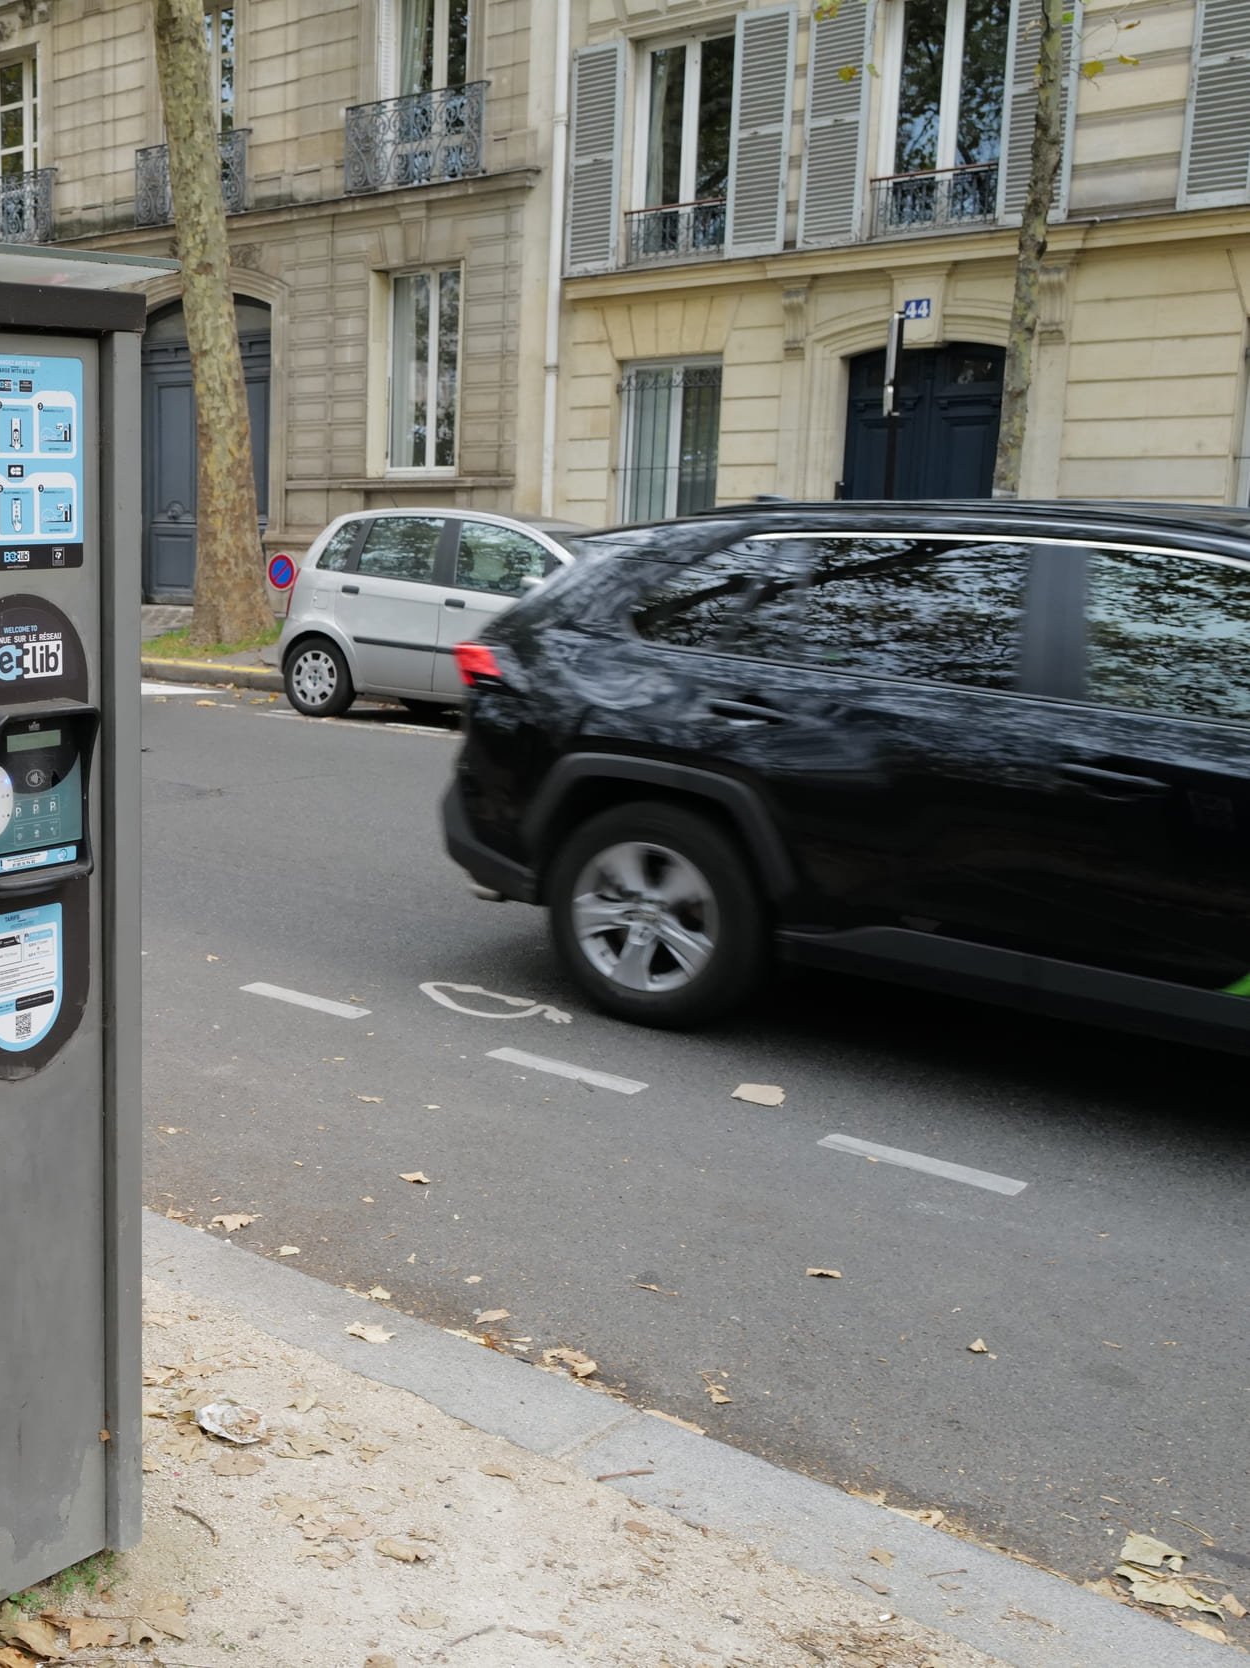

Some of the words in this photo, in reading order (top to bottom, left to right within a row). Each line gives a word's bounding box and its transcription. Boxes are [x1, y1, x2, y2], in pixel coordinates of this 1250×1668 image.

[905, 301, 928, 318] 44
[3, 625, 30, 634] WELCOME
[14, 635, 27, 643] SUR
[29, 634, 37, 642] LE
[39, 632, 62, 641] RÉSEAU
